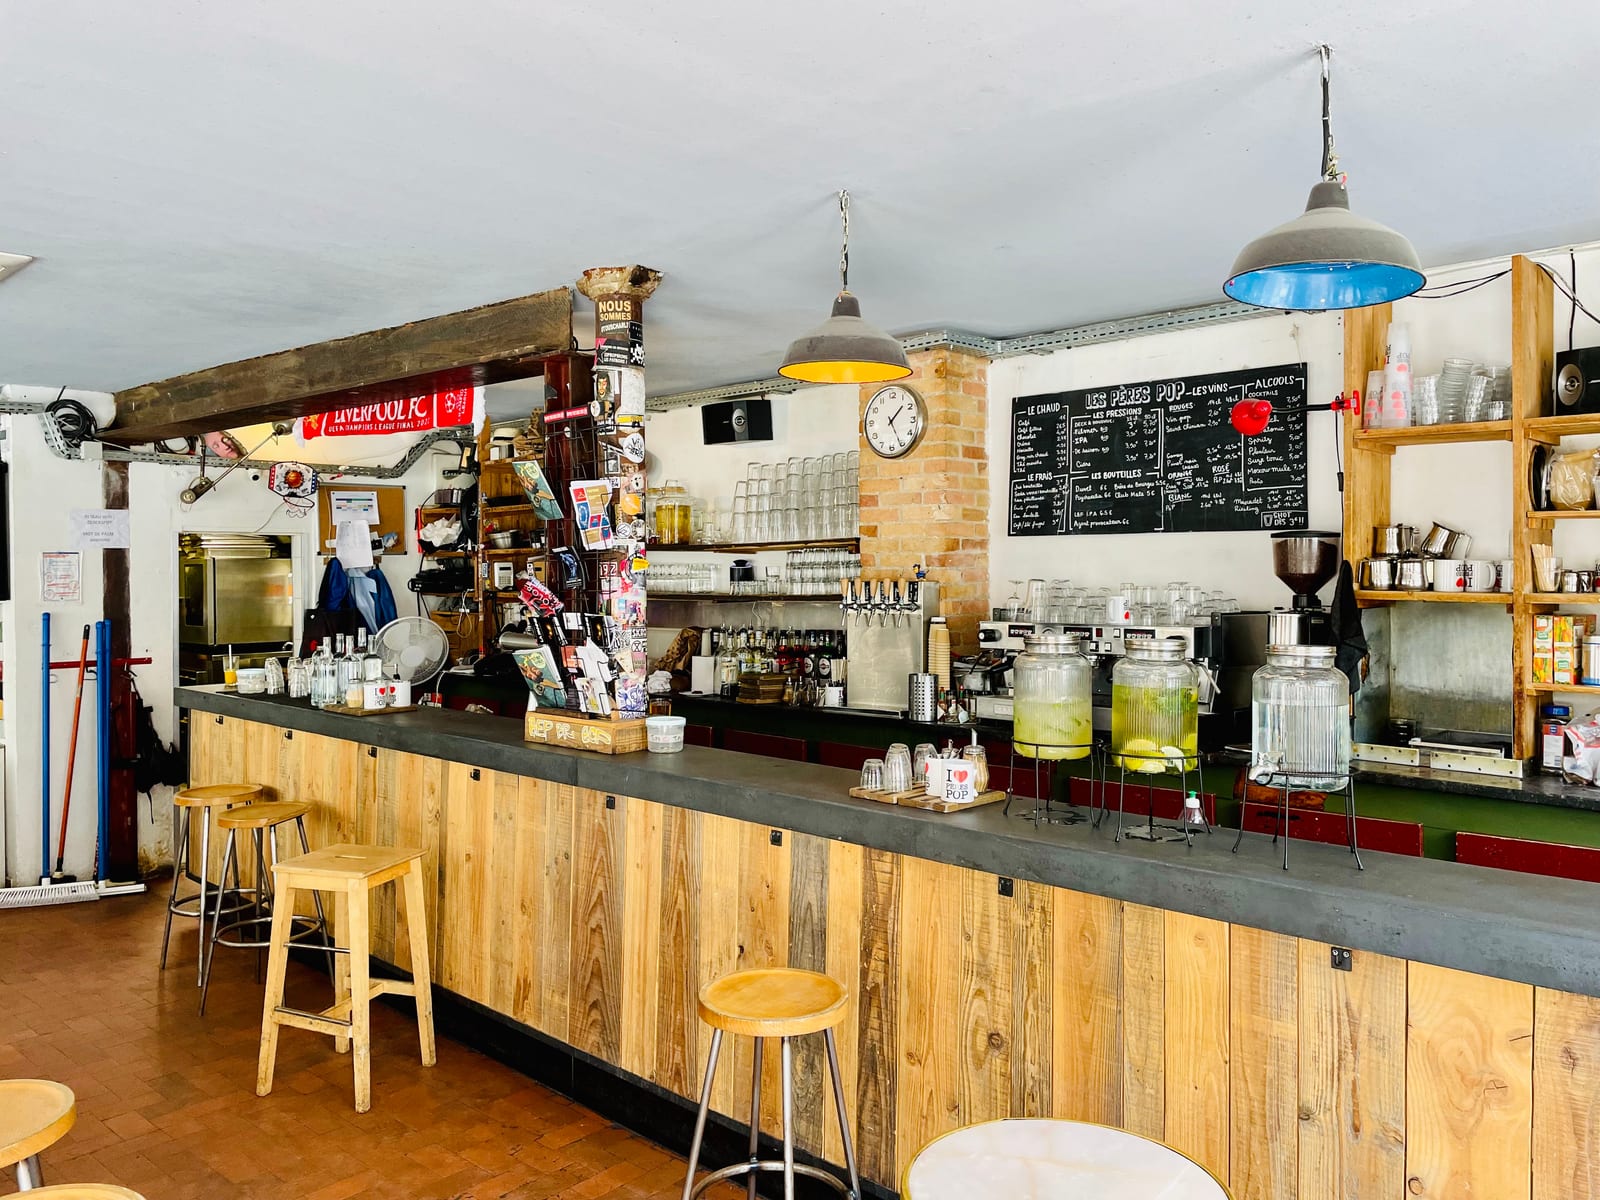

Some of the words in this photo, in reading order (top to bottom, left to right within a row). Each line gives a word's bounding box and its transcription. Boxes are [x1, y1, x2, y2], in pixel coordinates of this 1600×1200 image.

[598, 300, 631, 312] NOUS
[600, 312, 632, 321] SOMMES
[1255, 376, 1295, 390] ALCOOLS
[1086, 391, 1106, 410] LES
[1111, 384, 1150, 406] PÈRES
[1156, 381, 1186, 402] POP
[1192, 386, 1207, 396] LES
[408, 395, 427, 419] FC
[1028, 406, 1035, 415] LE
[1037, 402, 1060, 414] CHAUD
[910, 416, 916, 424] 3
[328, 425, 344, 433] UEFA
[374, 422, 395, 431] LEAGUE
[396, 420, 415, 429] FINAL
[1248, 438, 1272, 446] Spritz
[889, 444, 895, 452] 6
[1091, 472, 1102, 480] LES
[1103, 470, 1142, 479] BOUTEILLES
[1168, 492, 1192, 502] BLANC
[946, 769, 952, 782] I
[946, 790, 968, 800] POP
